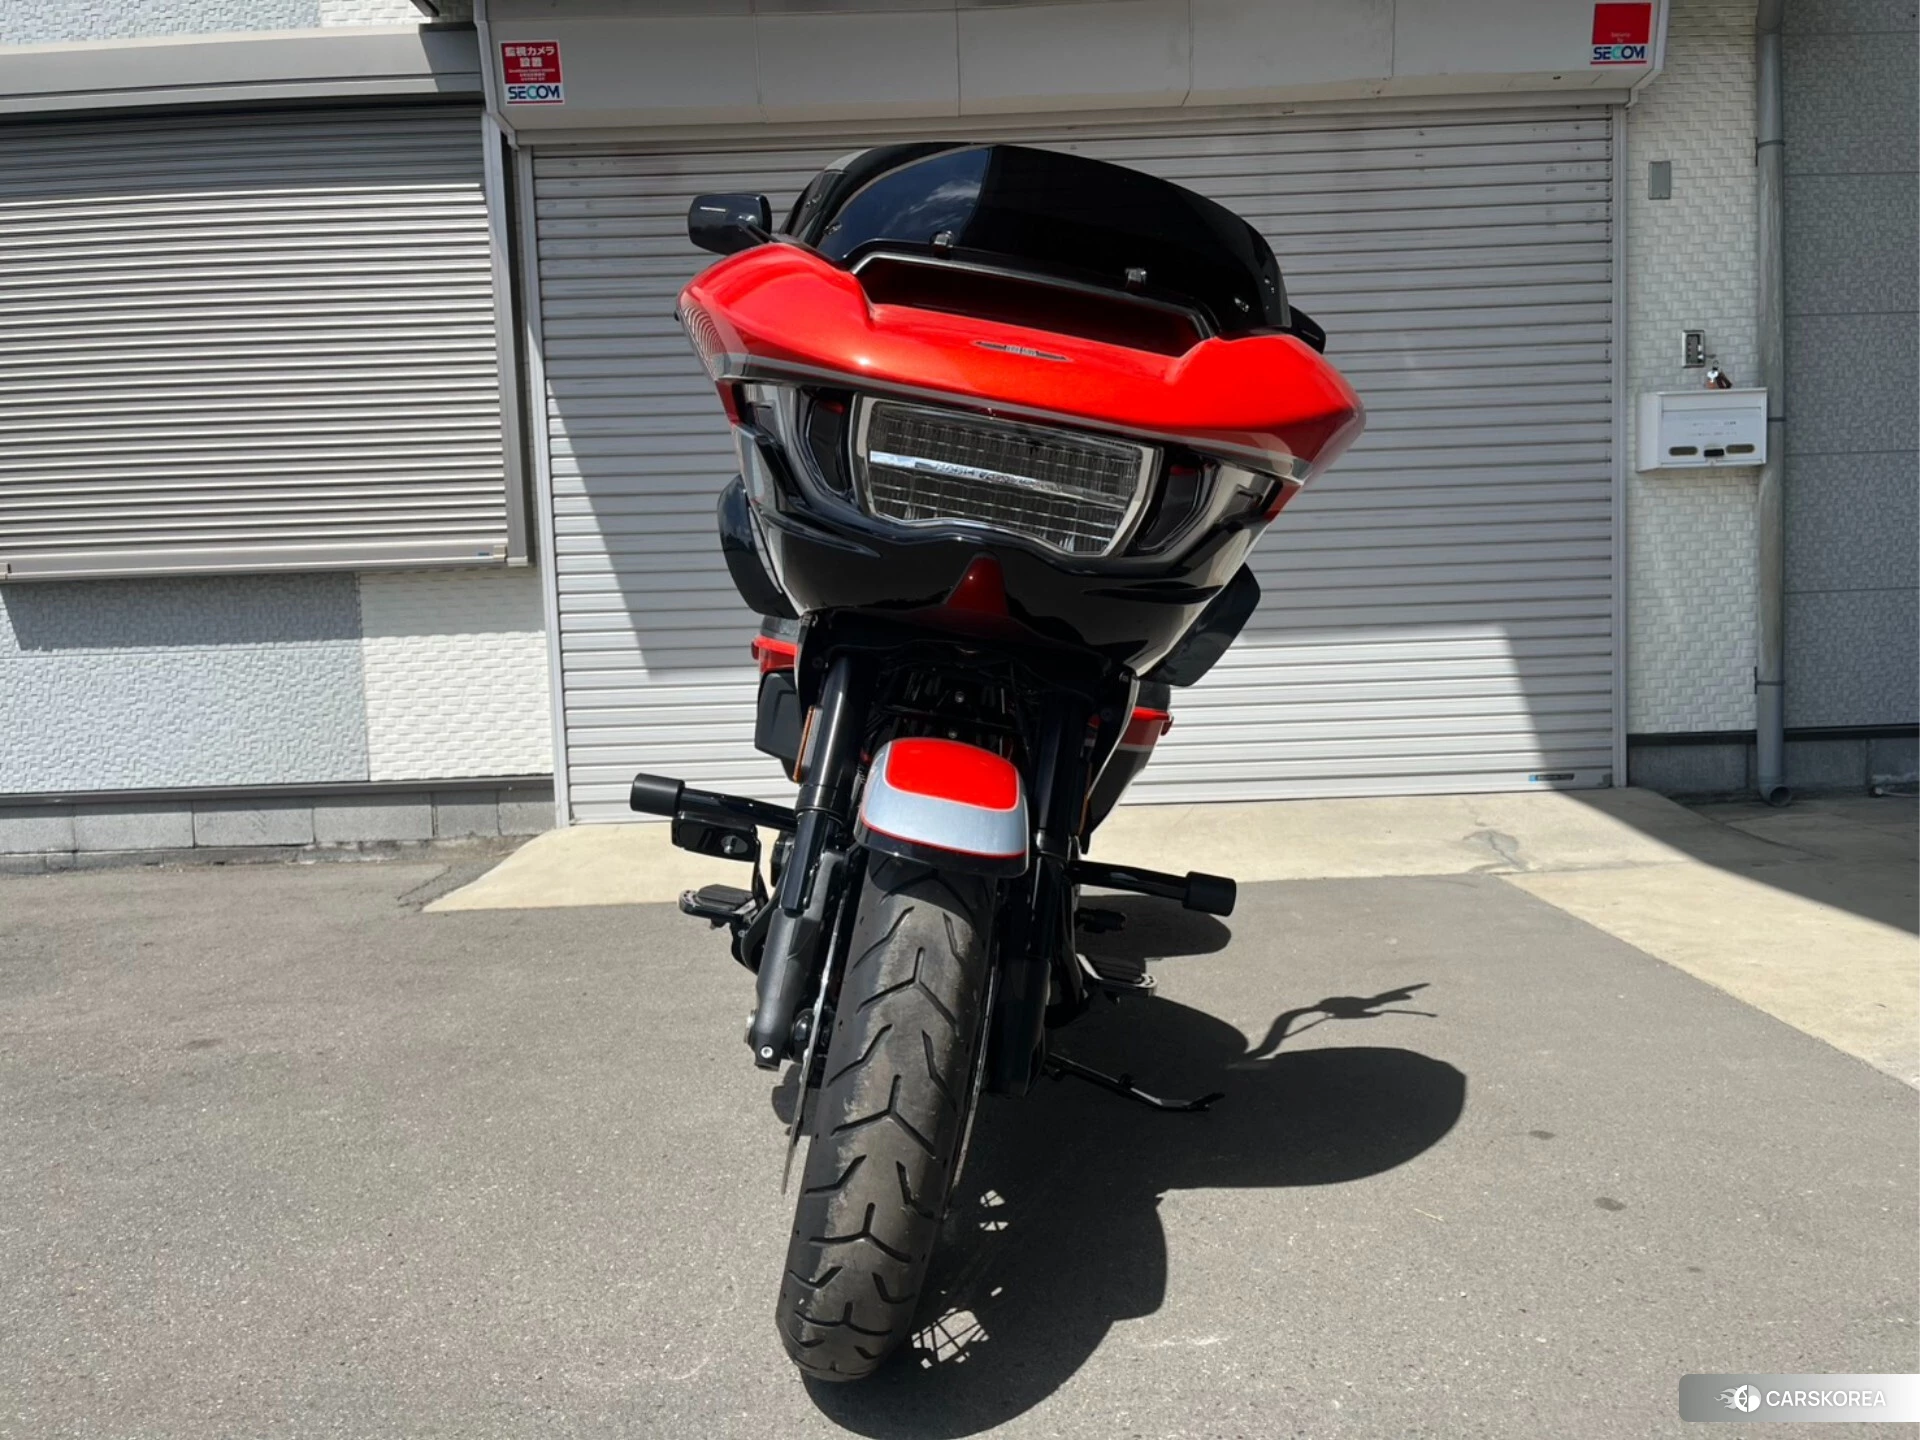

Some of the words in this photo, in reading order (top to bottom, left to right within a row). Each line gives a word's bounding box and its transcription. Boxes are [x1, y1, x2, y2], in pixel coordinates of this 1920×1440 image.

[505, 46, 555, 57] 監視カメラ
[1593, 45, 1645, 60] SECOM
[508, 85, 560, 99] SECOM
